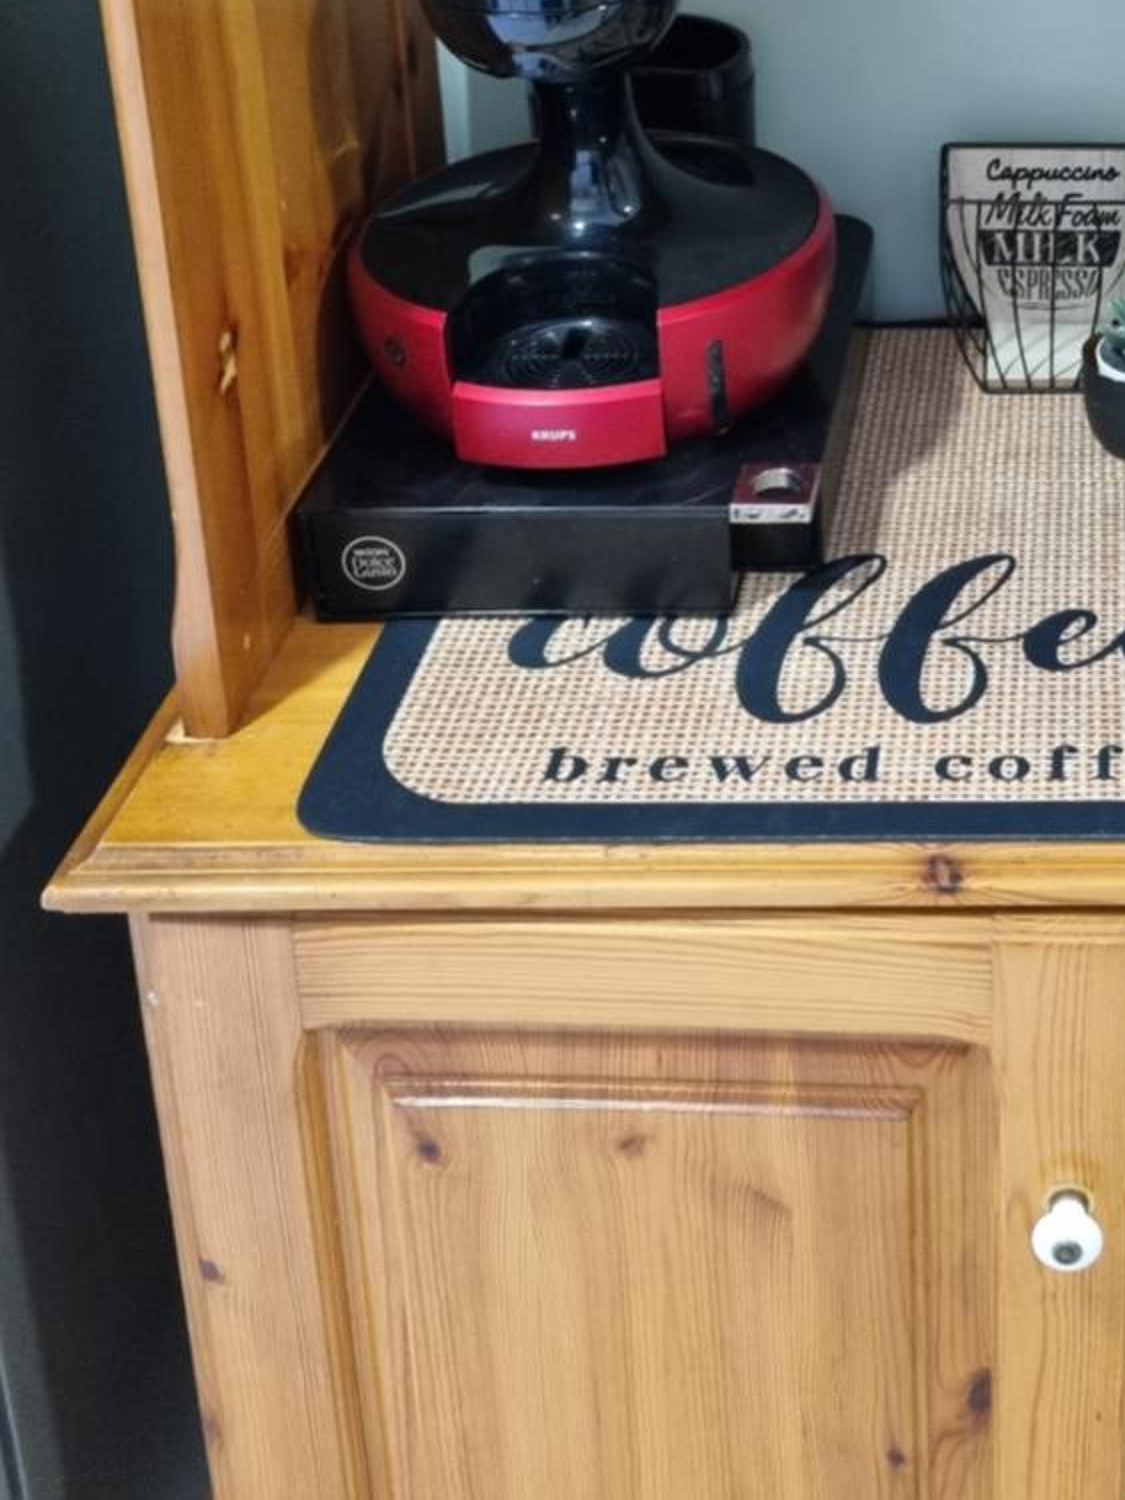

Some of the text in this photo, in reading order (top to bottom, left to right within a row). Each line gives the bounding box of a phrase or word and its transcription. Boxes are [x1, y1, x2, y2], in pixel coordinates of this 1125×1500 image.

[986, 158, 1120, 190] Cappuccino
[984, 192, 1121, 228] Milk Foam
[992, 232, 1101, 263] MILK
[531, 429, 577, 442] KRUPS
[543, 746, 880, 783] brewed
